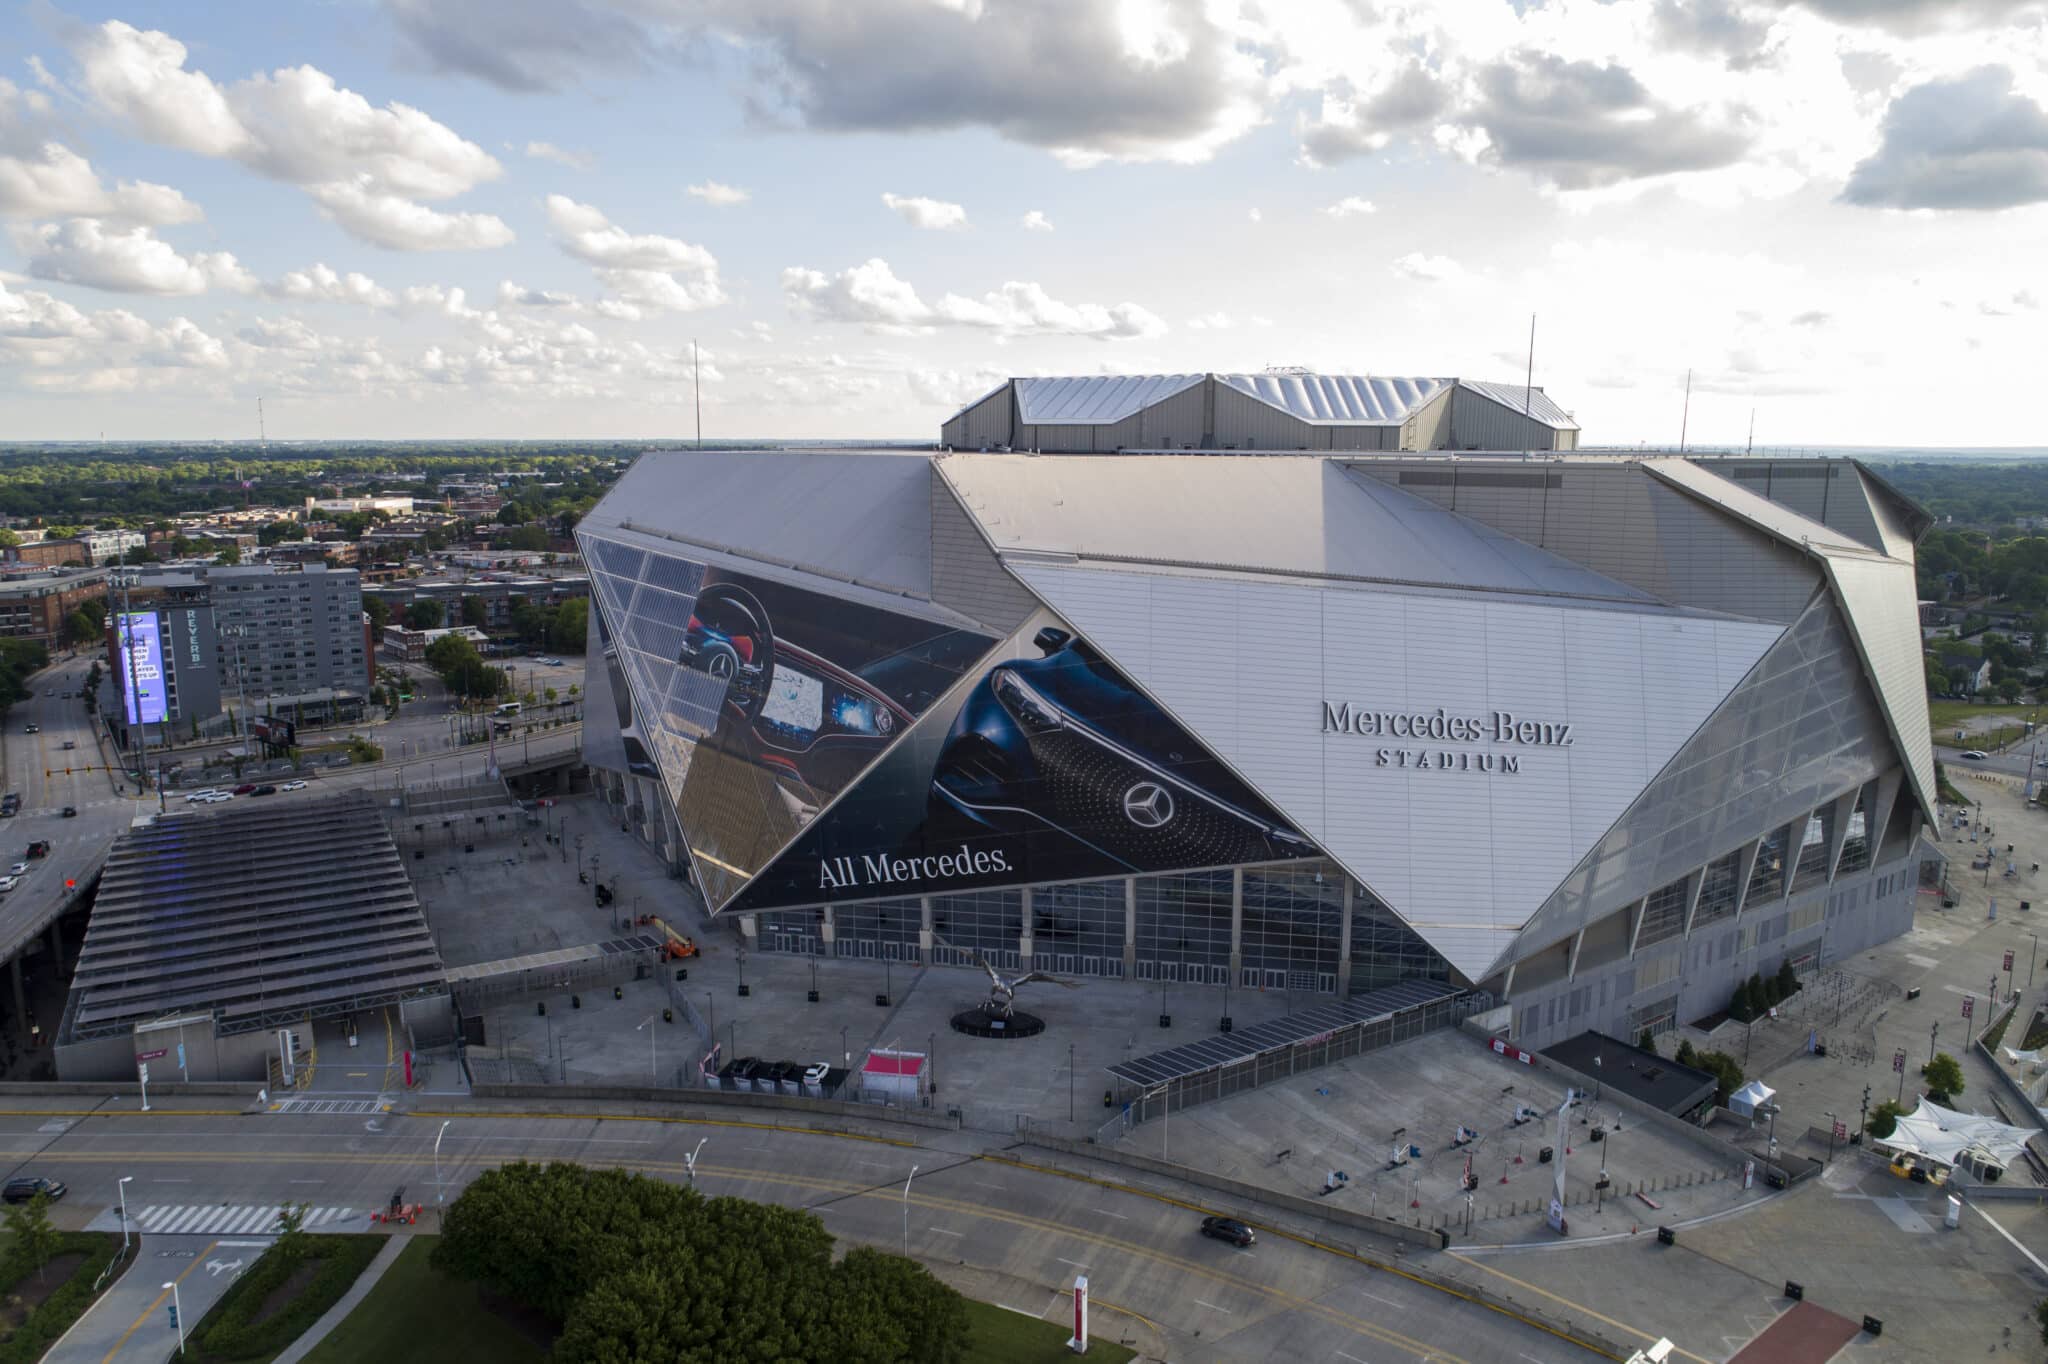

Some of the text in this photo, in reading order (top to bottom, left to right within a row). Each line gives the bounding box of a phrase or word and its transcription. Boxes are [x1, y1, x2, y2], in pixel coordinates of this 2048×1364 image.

[187, 609, 201, 662] REVERB
[1322, 700, 1575, 746] Mercedes-Benz
[1376, 748, 1522, 773] STADIUM
[819, 844, 1013, 888] All Mercedes.
